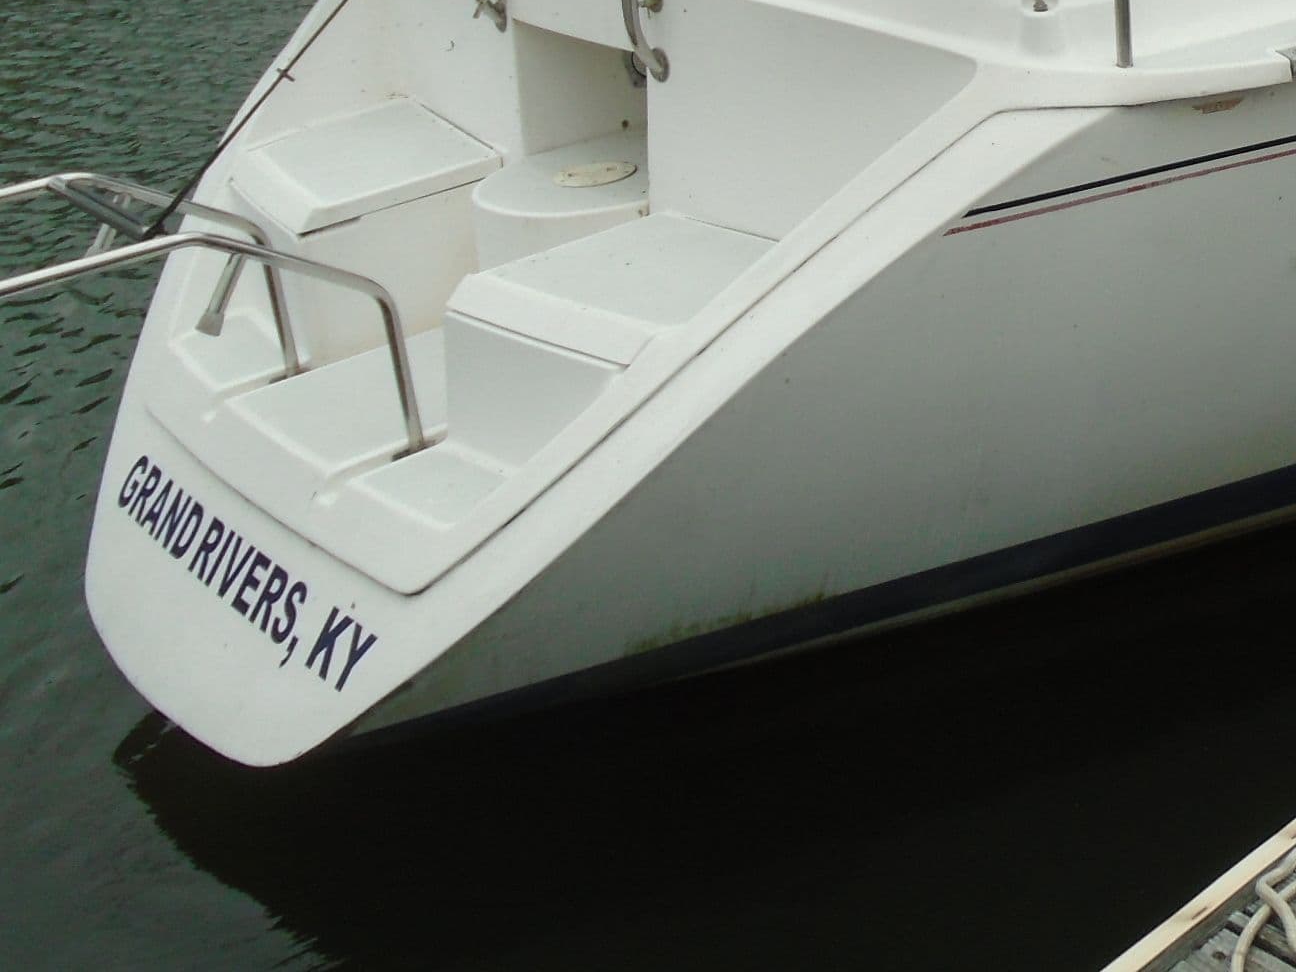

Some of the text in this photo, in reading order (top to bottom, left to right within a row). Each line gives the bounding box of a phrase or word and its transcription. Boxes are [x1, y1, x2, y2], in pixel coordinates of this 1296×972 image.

[117, 455, 378, 692] GRAND RIVERS, KY
